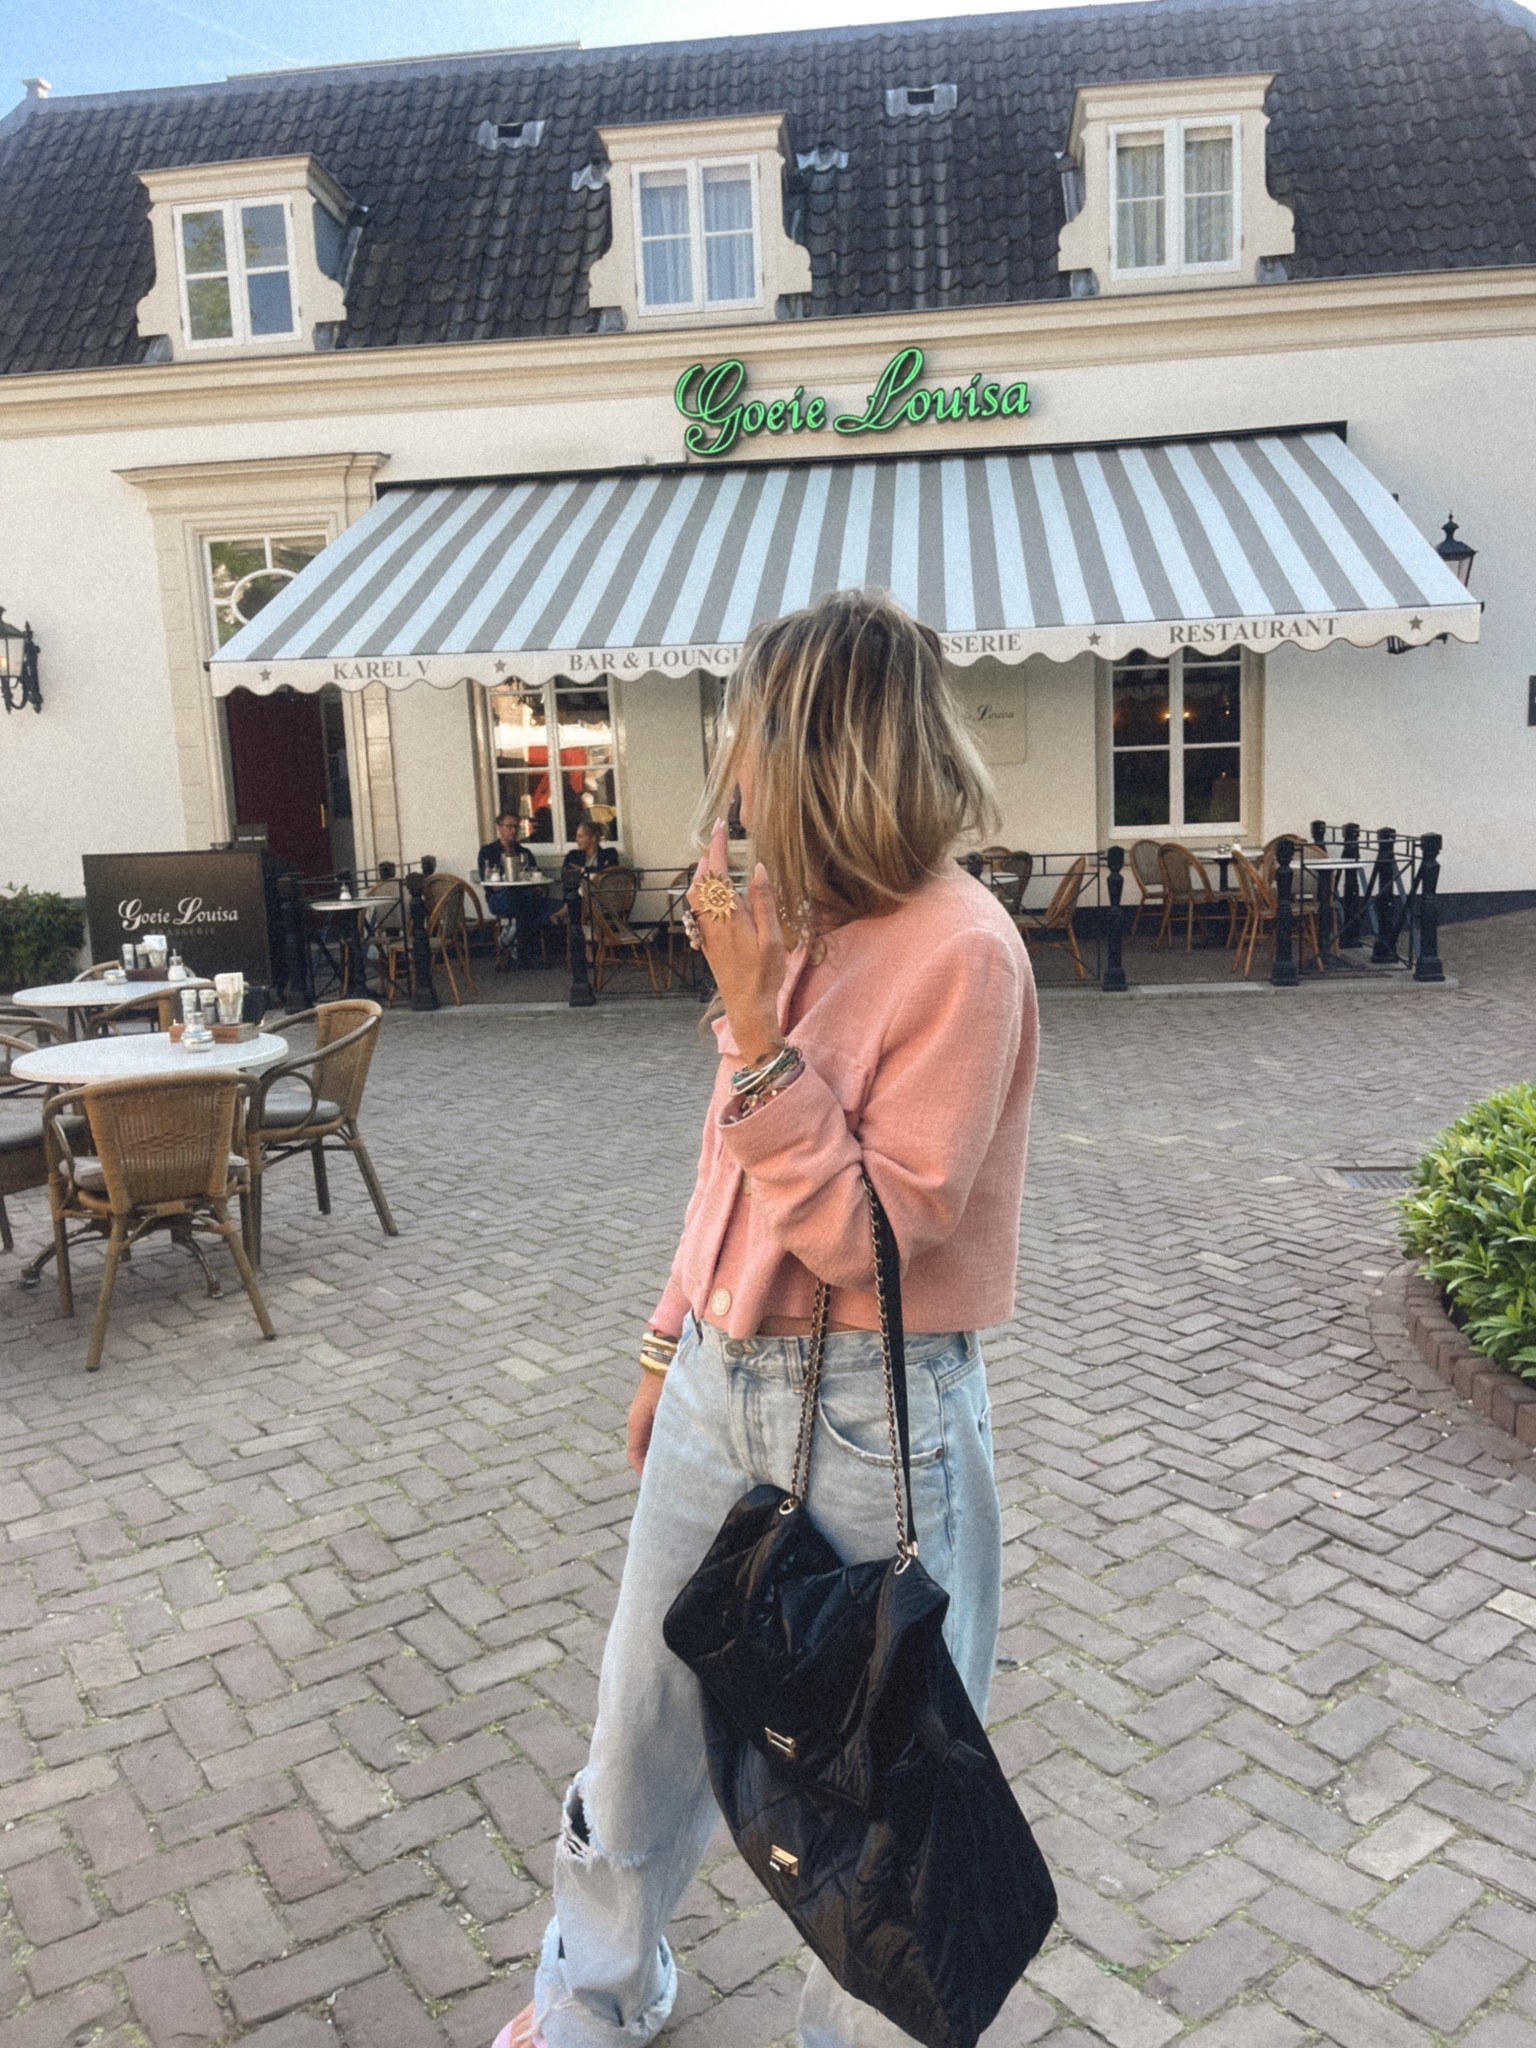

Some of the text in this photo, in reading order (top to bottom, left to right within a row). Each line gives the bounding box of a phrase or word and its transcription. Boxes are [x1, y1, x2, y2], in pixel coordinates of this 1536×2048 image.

[674, 346, 1032, 455] Goeie Louisa
[1169, 617, 1339, 644] RESTAURANT
[942, 634, 1022, 654] SSERIE
[333, 659, 432, 680] KAREL V
[569, 653, 617, 671] BAR
[623, 652, 640, 669] &
[118, 896, 239, 931] Goeie Louisa
